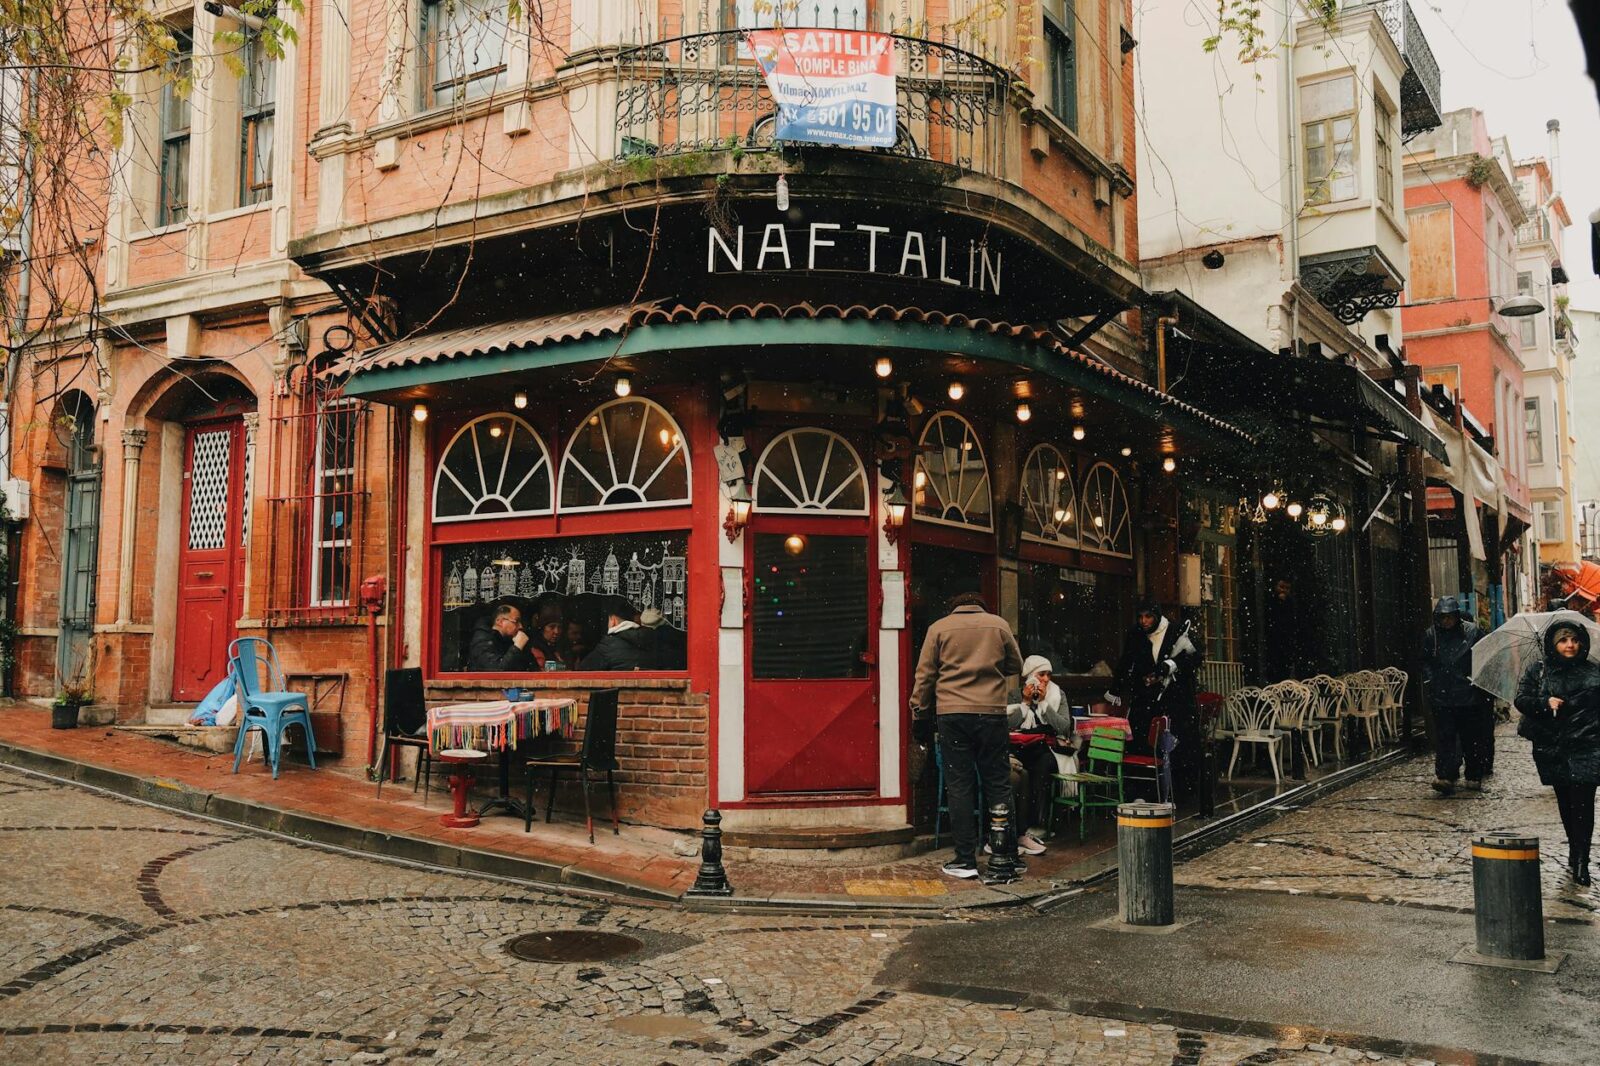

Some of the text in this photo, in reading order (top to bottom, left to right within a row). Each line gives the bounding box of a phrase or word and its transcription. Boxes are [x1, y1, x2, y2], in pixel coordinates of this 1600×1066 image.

[783, 32, 888, 56] SATILIK
[794, 57, 845, 75] KOMPLE
[819, 104, 846, 128] 501
[852, 103, 871, 132] 95
[875, 107, 894, 134] 01
[1301, 523, 1336, 532] NOMAD
